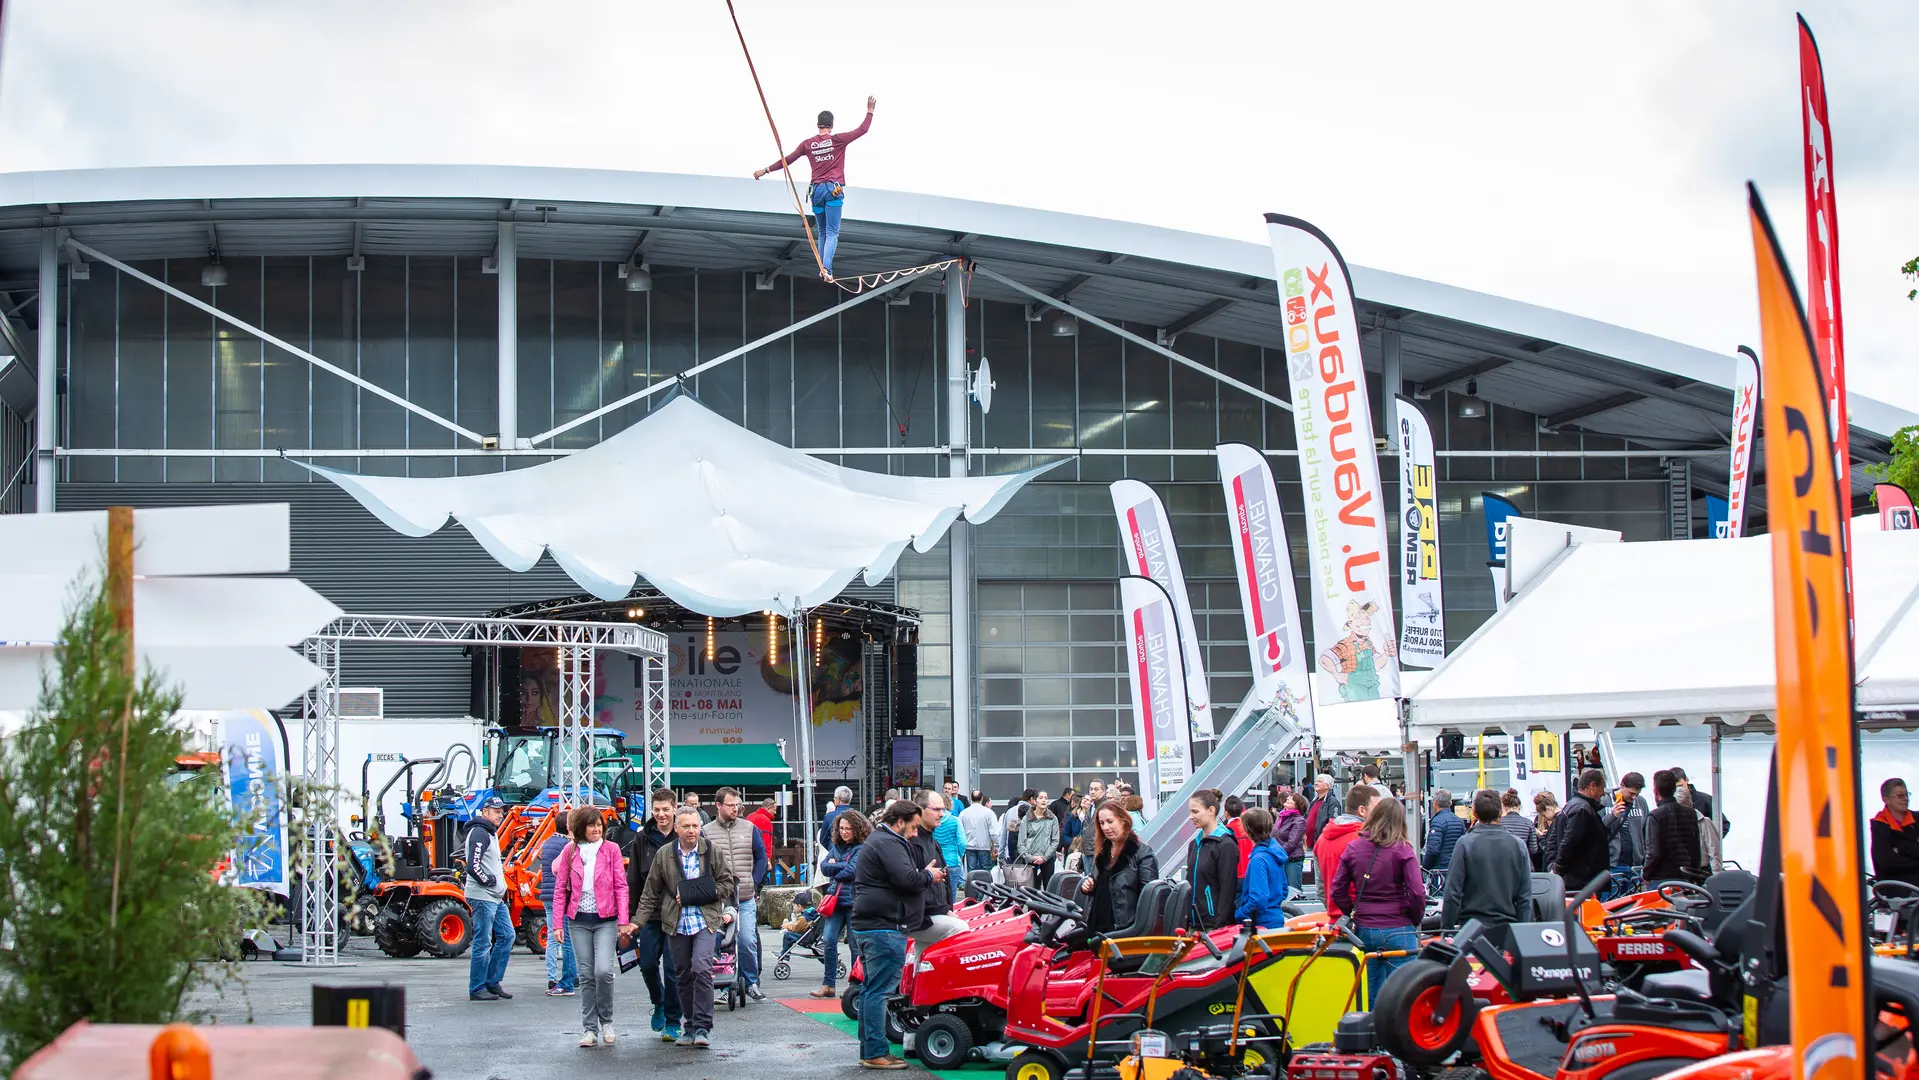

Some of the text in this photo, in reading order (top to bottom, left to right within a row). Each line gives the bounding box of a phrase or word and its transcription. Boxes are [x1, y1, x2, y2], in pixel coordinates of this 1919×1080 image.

[717, 699, 742, 709] MAI
[1617, 943, 1664, 955] FERRIS
[960, 950, 1006, 964] HONDA
